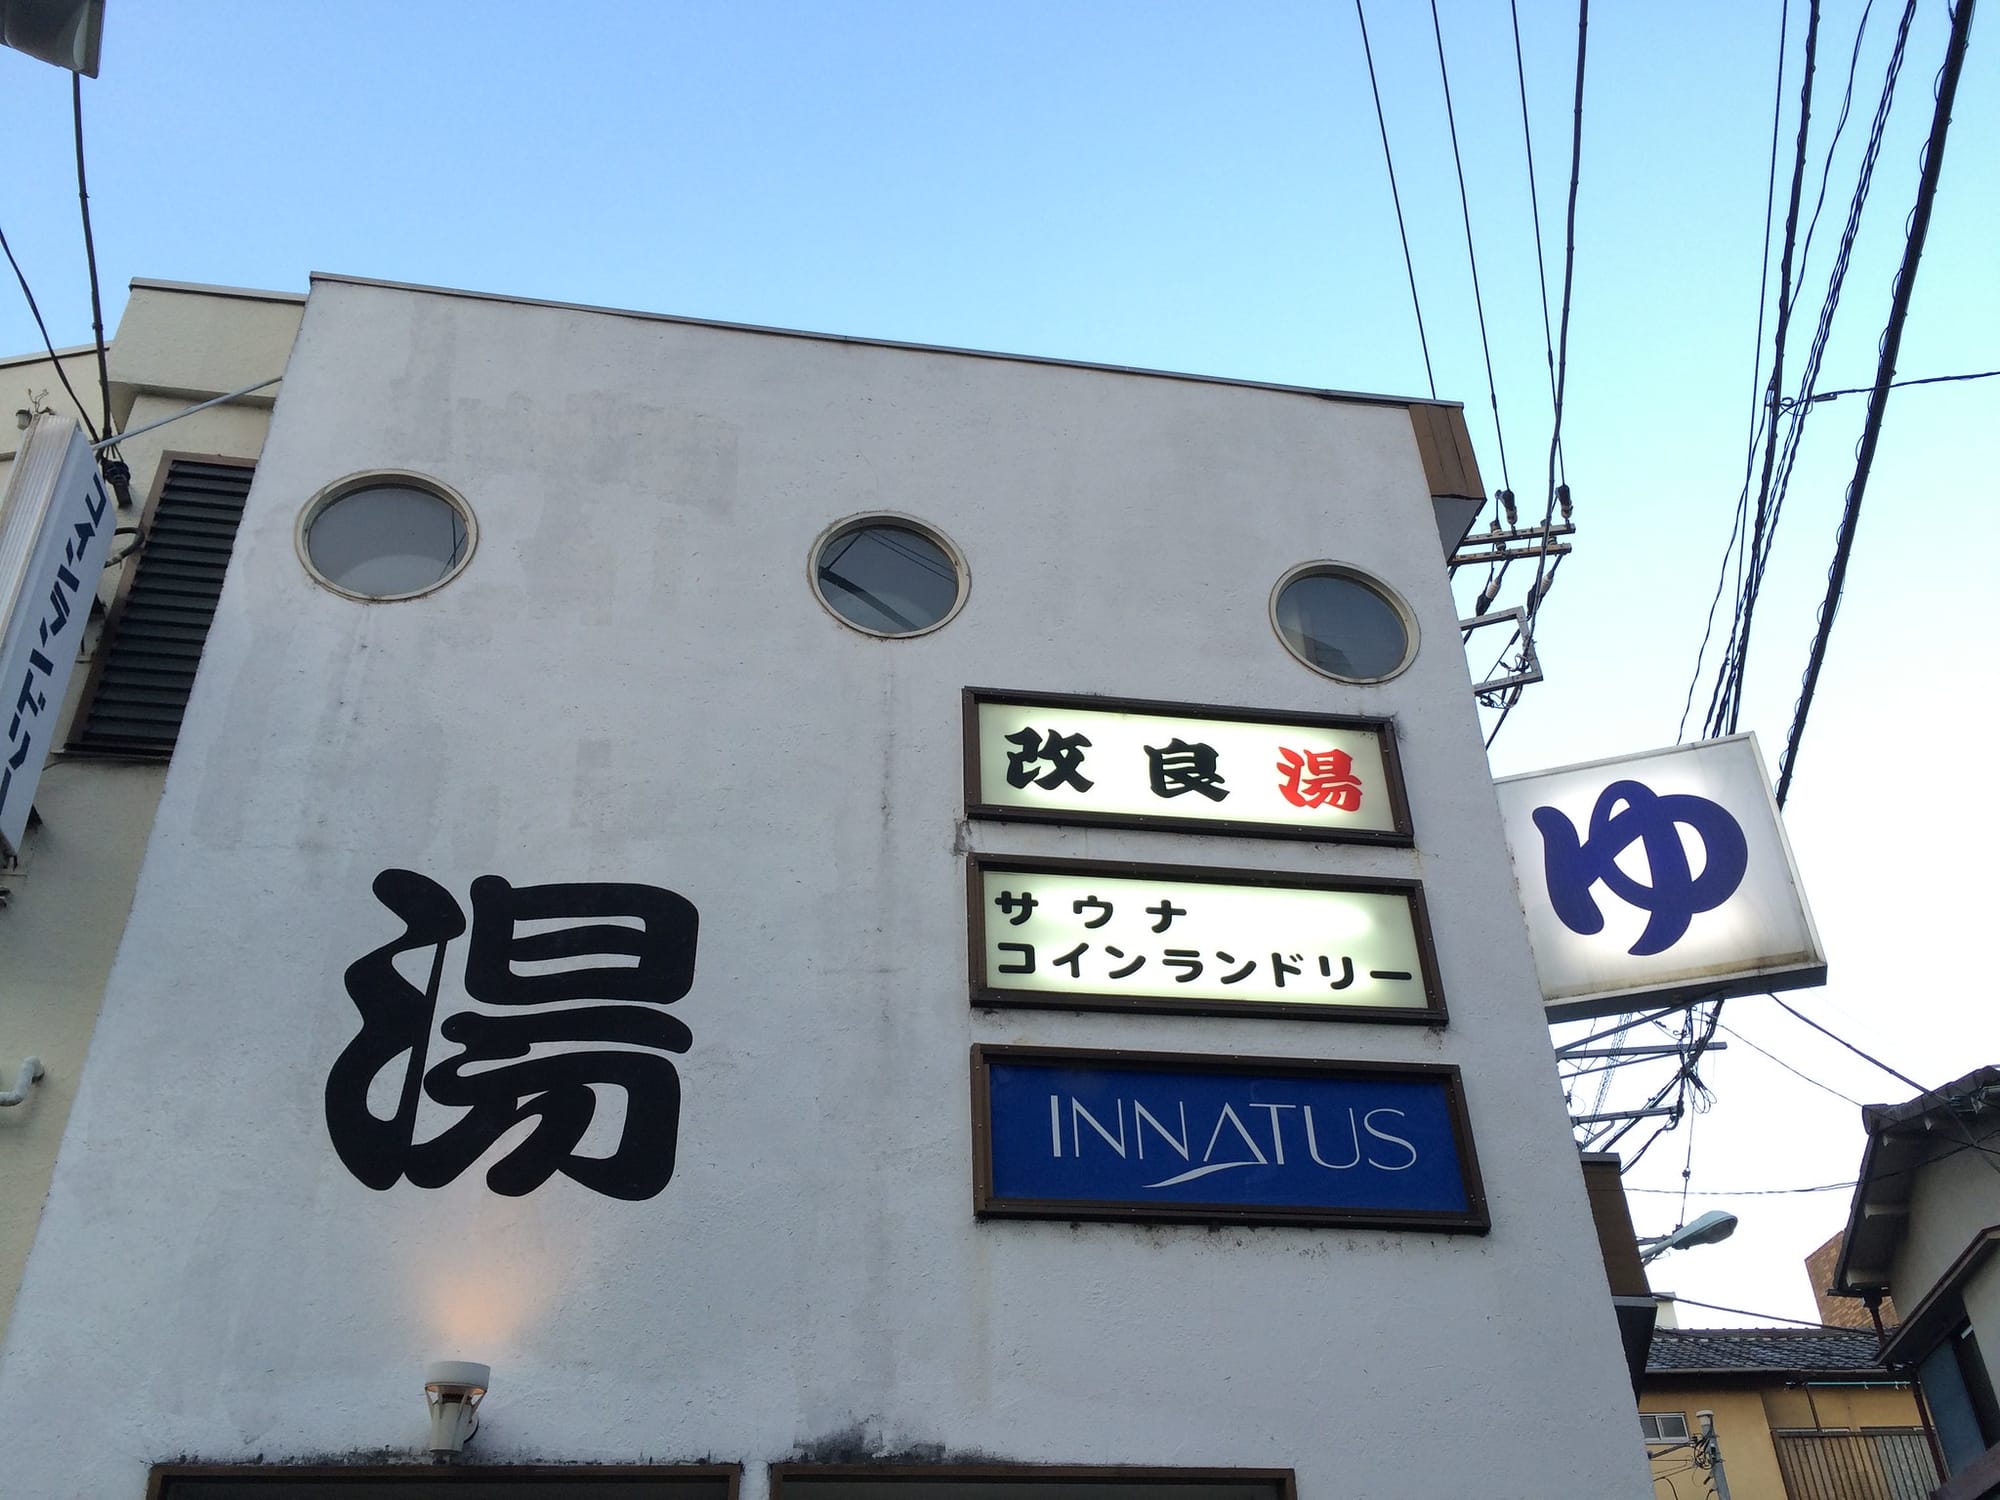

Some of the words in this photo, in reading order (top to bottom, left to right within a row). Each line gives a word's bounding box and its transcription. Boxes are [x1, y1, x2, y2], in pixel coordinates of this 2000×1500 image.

[1004, 726, 1362, 812] 改良湯
[994, 890, 1187, 934] サウナ
[1531, 779, 1749, 957] ゆ
[997, 942, 1413, 990] コインランドリー
[325, 868, 700, 1202] 湯
[1050, 1094, 1418, 1188] INNATUS
